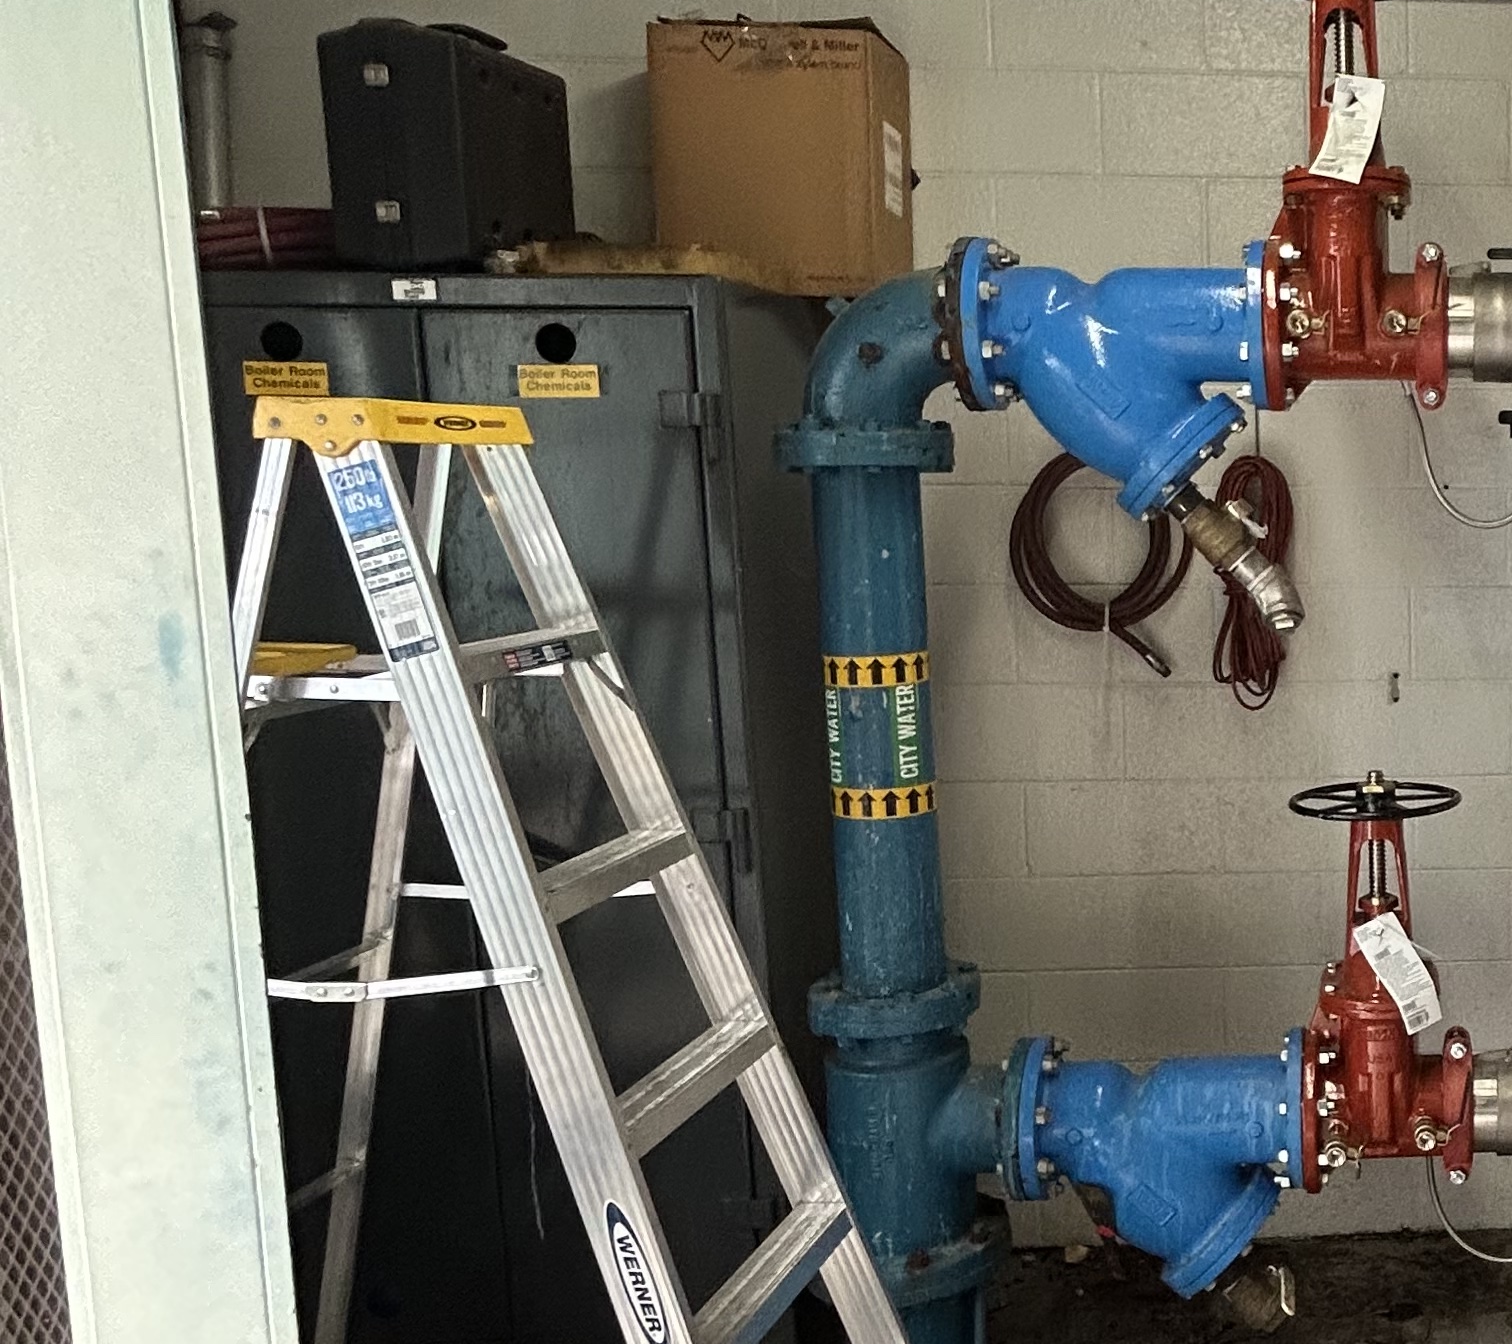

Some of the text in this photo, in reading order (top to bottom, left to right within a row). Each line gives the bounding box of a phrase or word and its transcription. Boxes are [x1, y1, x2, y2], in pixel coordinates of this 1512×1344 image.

[824, 39, 860, 51] Miller
[244, 365, 326, 376] Boiler Room
[519, 367, 597, 379] Boiler Room
[253, 377, 321, 389] Chemicals
[526, 380, 592, 391] Chemicals
[333, 466, 367, 491] 250
[344, 491, 367, 514] 113
[825, 688, 843, 784] CITY WATER
[895, 683, 919, 779] CITY WATER
[616, 1234, 663, 1333] WERNER
